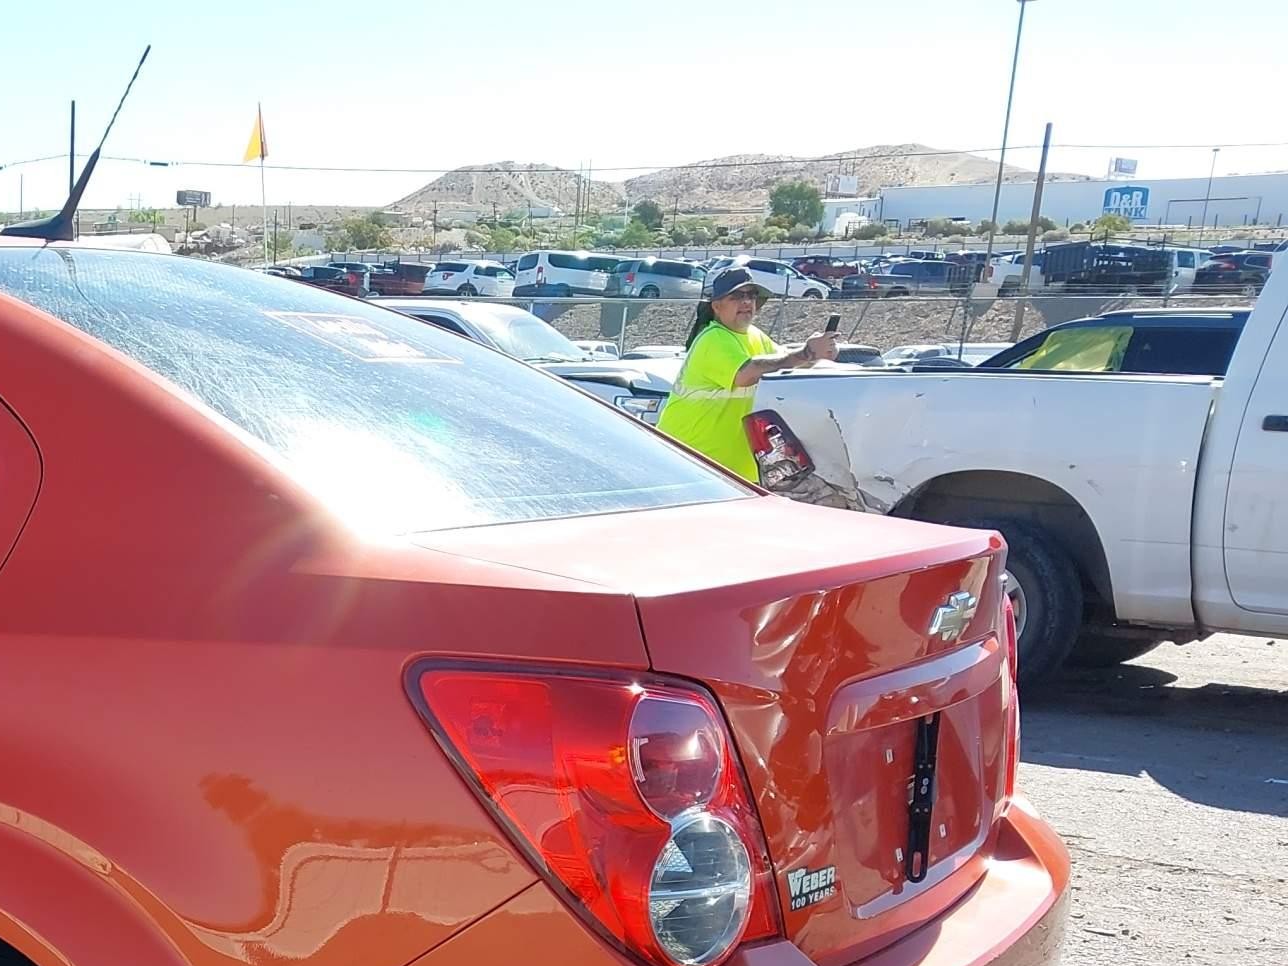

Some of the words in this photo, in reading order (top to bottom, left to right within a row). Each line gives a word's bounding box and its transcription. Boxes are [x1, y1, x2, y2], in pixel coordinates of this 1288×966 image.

[1110, 190, 1143, 208] D&R
[787, 866, 836, 898] WEBER
[791, 896, 806, 910] 100
[808, 886, 835, 904] YEARS
